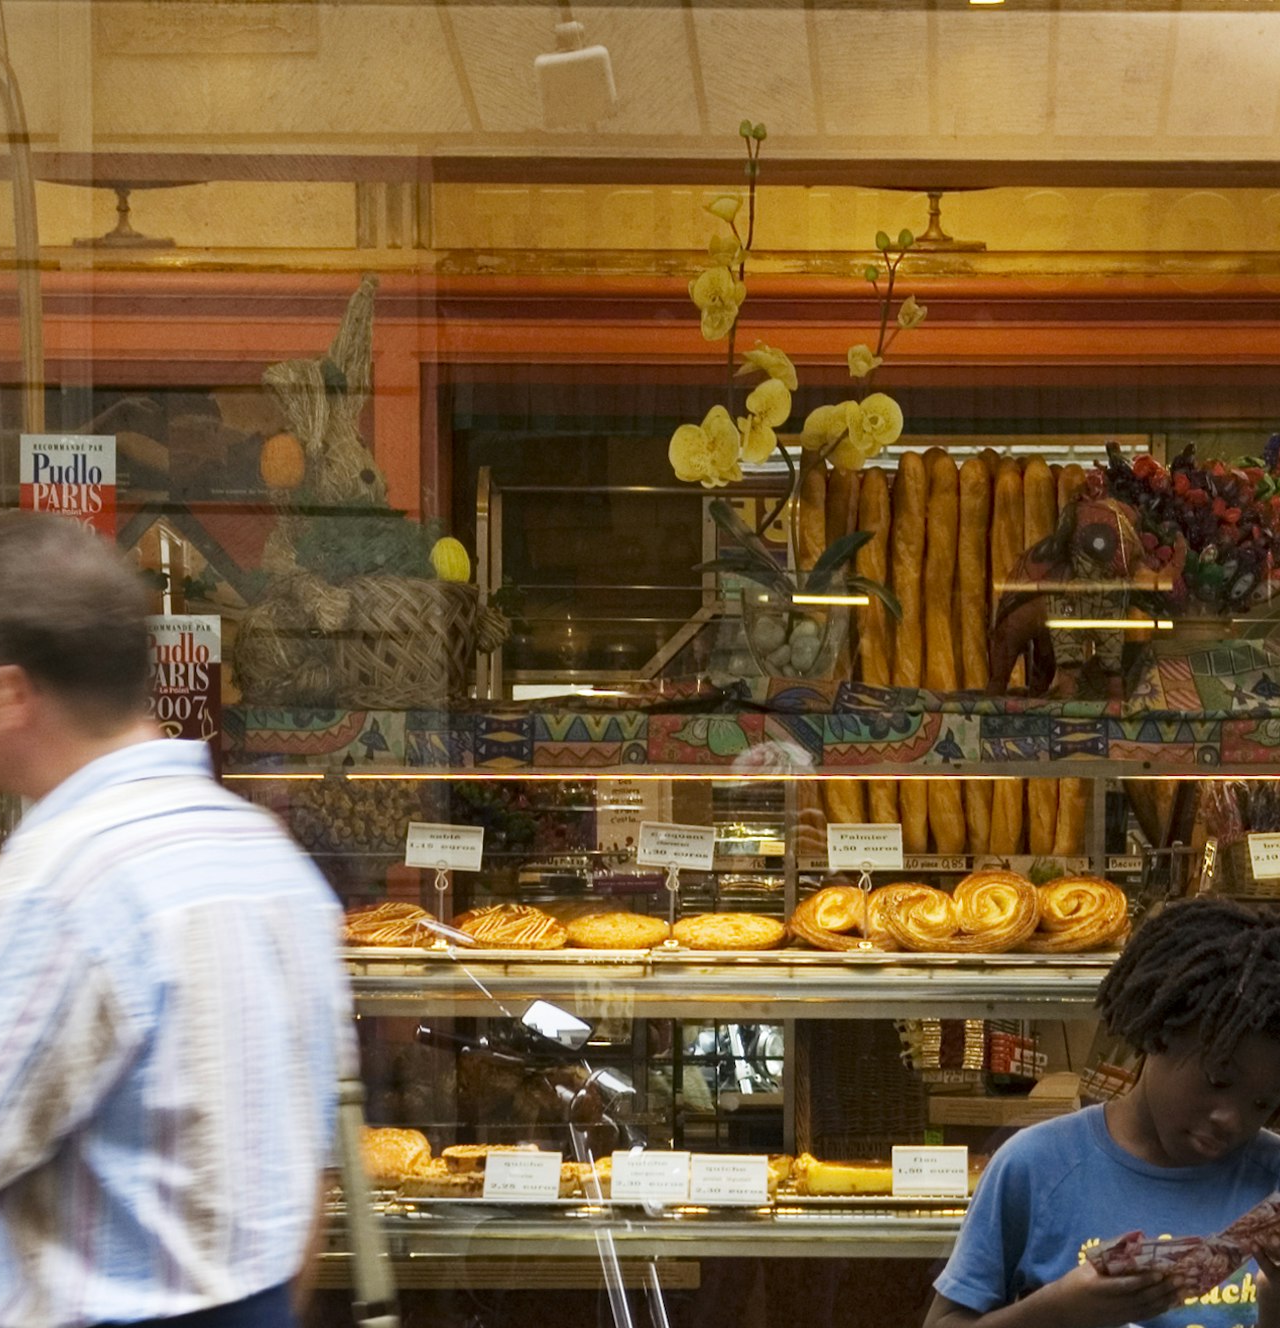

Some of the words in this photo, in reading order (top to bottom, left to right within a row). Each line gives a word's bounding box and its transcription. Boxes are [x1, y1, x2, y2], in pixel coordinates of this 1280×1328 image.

[32, 453, 102, 485] Pudlo
[32, 483, 102, 513] PARIS
[145, 695, 207, 720] 2007
